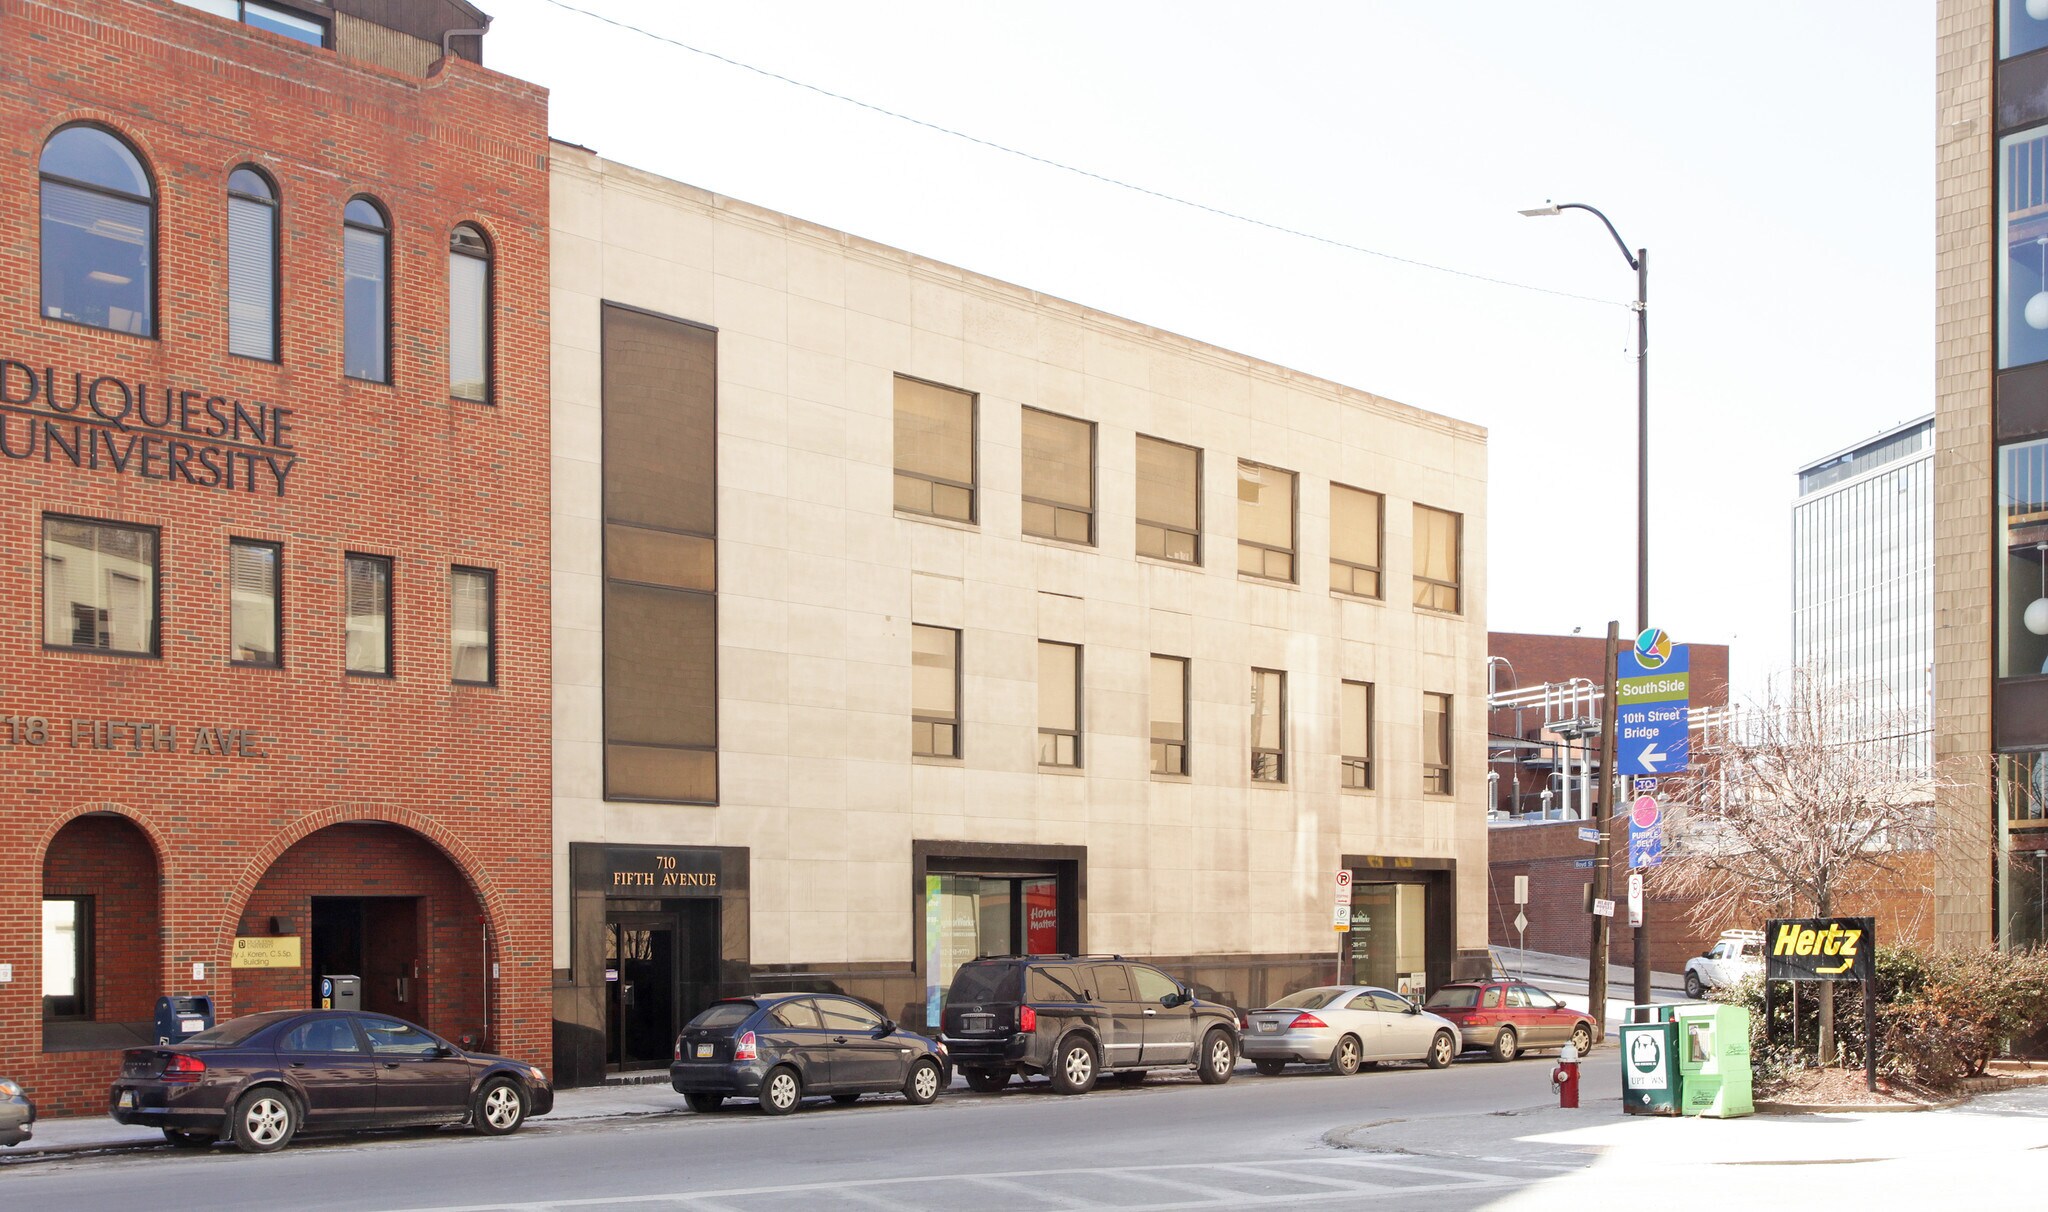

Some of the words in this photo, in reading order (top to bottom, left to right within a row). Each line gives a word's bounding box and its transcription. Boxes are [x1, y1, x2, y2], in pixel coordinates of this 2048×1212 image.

[0, 359, 294, 449] DUQUESNE
[0, 413, 297, 497] UNIVERSITY
[1622, 679, 1686, 696] SouthSide
[1623, 713, 1645, 724] 10th
[1648, 710, 1680, 721] Street
[0, 715, 50, 745] 18
[71, 718, 177, 752] FIFTH
[193, 727, 269, 757] AVE.
[1624, 727, 1660, 739] Bridge
[1639, 780, 1652, 789] TO
[1632, 831, 1659, 839] PURPLE
[656, 856, 676, 869] 710
[613, 872, 655, 886] FIFTH
[662, 873, 717, 886] AVENUE
[1030, 918, 1057, 931] Matter
[1773, 923, 1862, 956] Hertz
[323, 982, 329, 995] P
[323, 1000, 329, 1009] 2
[1631, 1077, 1664, 1085] UPTWN
